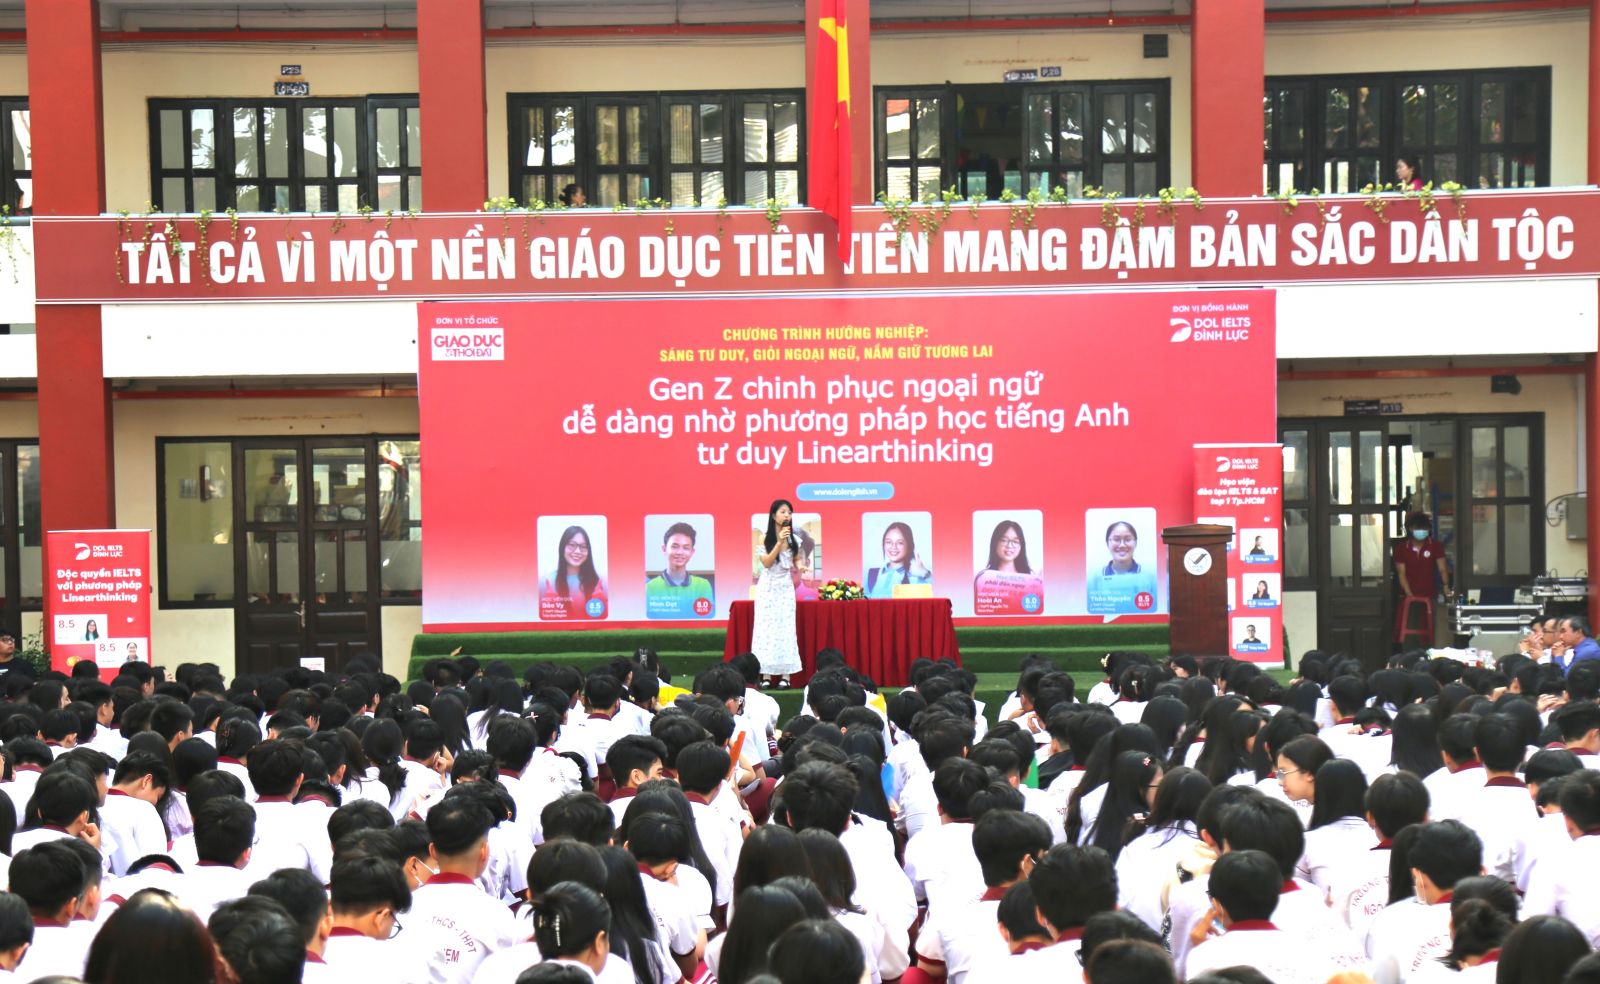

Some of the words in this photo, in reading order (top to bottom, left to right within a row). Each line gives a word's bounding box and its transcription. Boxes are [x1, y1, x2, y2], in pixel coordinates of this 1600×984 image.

[122, 223, 196, 284] TẤT
[210, 226, 266, 284] CẢ
[277, 231, 316, 283] VÌ
[330, 229, 418, 291] MỘT
[431, 223, 516, 281] NỀN
[530, 227, 625, 280] GIÁO
[639, 234, 721, 288] DỤC
[733, 224, 825, 277] TIÊN
[943, 228, 1068, 273] MANG
[1080, 216, 1176, 279] ĐẬM
[1190, 209, 1277, 268] BẢN
[1290, 206, 1376, 267] SẮC
[1390, 210, 1479, 264] DÂN
[1492, 207, 1574, 271] TỘC
[1172, 304, 1190, 313] ĐƠN
[436, 317, 453, 325] ĐƠN
[1194, 318, 1219, 328] DOL
[1222, 316, 1252, 328] IELTS
[723, 326, 778, 342] CHƯƠNG
[781, 325, 822, 340] TRÌNH
[876, 324, 929, 342] NGHIỆP:
[1194, 328, 1223, 341] ĐÌNH
[1226, 329, 1249, 342] LỰC
[660, 346, 694, 362] SÁNG
[698, 348, 716, 362] TƯ
[719, 349, 750, 364] DUY,
[753, 345, 780, 361] GIỎI
[784, 348, 825, 364] NGOẠI
[828, 345, 860, 362] NGỮ,
[924, 344, 968, 358] TƯƠNG
[972, 344, 993, 358] LAI
[650, 377, 704, 401] Gen
[714, 376, 733, 400] Z
[742, 375, 816, 400] chinh
[827, 374, 894, 404] phục
[903, 373, 978, 402] ngoại
[988, 370, 1044, 402] ngữ
[562, 404, 597, 434] dễ
[606, 408, 674, 438] dàng
[684, 407, 737, 433] nhờ
[746, 408, 848, 438] phương
[860, 405, 928, 436] pháp
[938, 406, 987, 434] học
[995, 402, 1065, 434] tiếng
[1074, 402, 1130, 428] Anh
[697, 442, 730, 465] tư
[736, 441, 788, 470] duy
[798, 438, 993, 468] Linearthinking
[813, 486, 879, 496] www.dolenglish.vn
[1228, 487, 1252, 496] IELTS
[1252, 487, 1260, 495] &
[1260, 486, 1278, 495] SAT
[1210, 498, 1225, 506] top
[1232, 497, 1266, 506] Tp.HCM
[57, 569, 78, 580] Độc
[113, 568, 142, 578] IELTS
[57, 581, 73, 590] với
[75, 580, 114, 592] phương
[116, 580, 142, 591] pháp
[62, 592, 138, 603] Linearthinking
[58, 620, 75, 628] 8.5
[100, 643, 116, 652] 8.5
[458, 930, 476, 952] THPT
